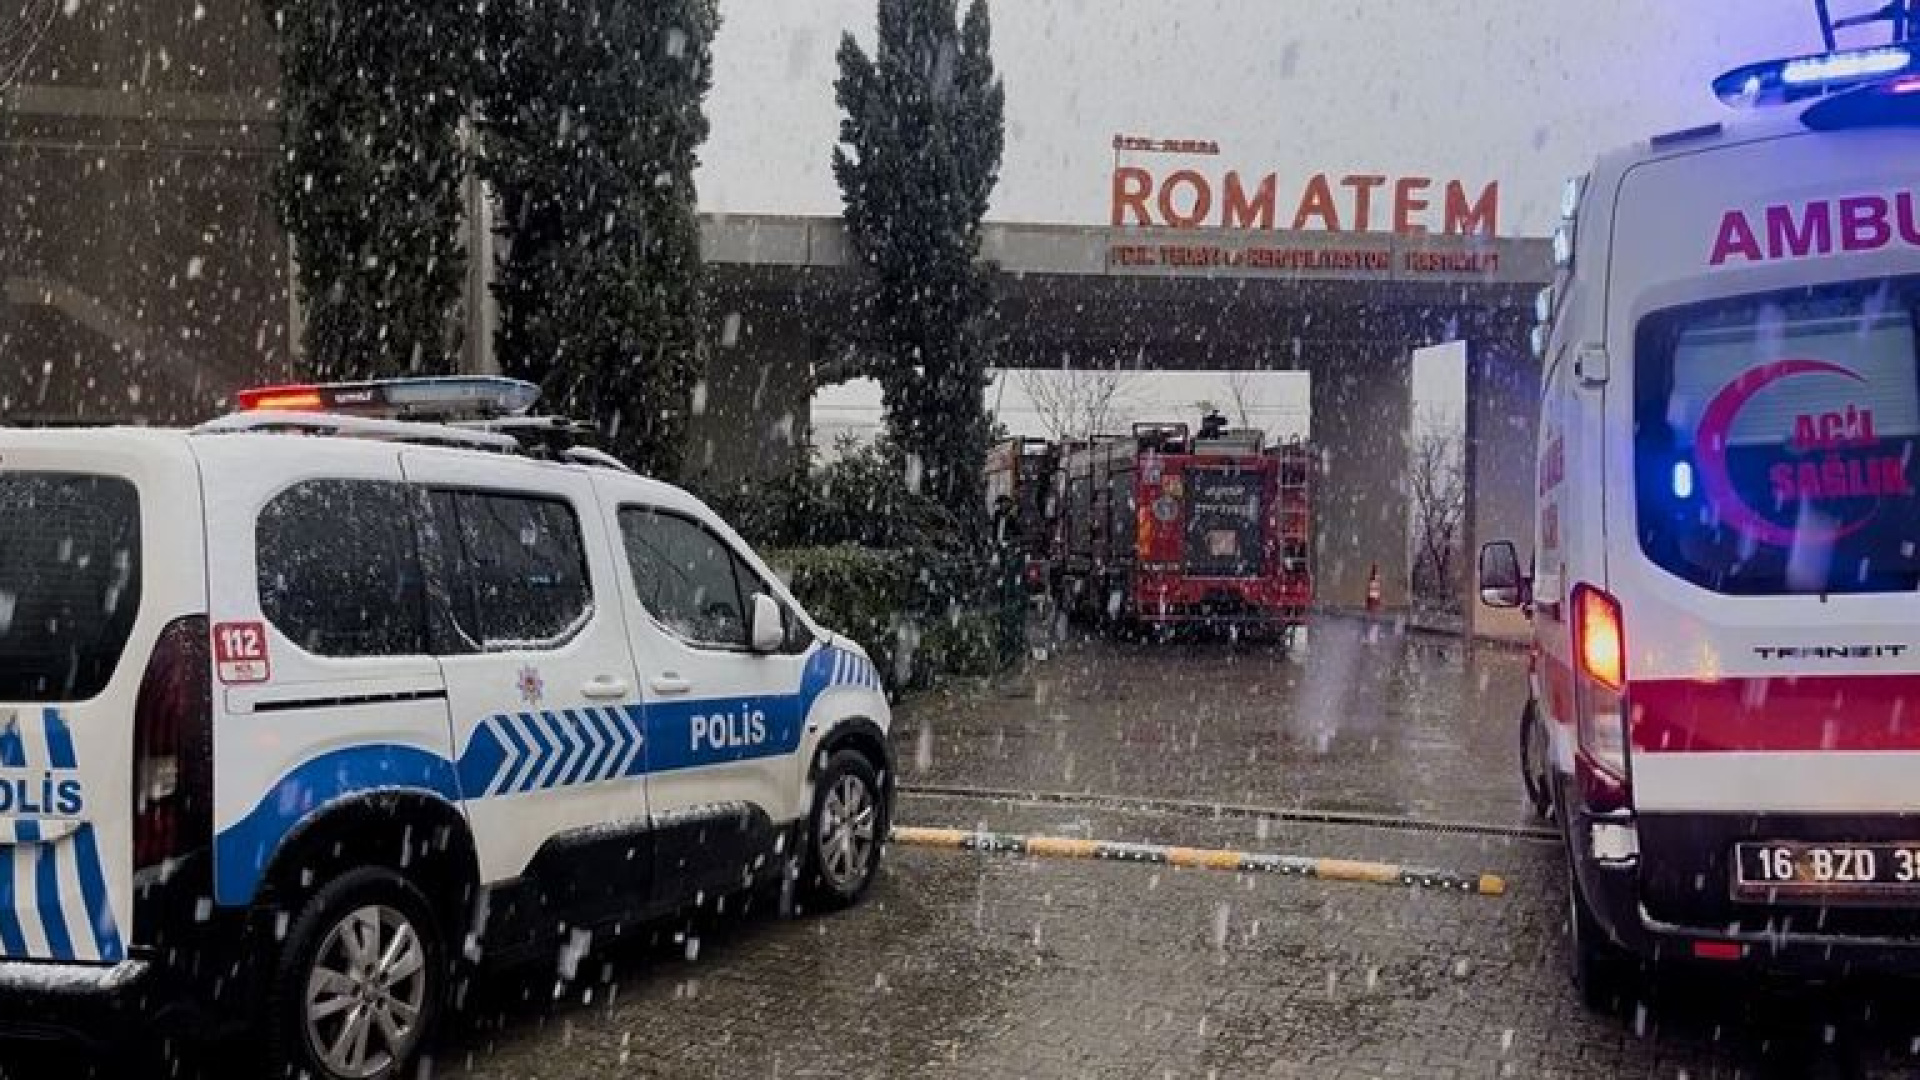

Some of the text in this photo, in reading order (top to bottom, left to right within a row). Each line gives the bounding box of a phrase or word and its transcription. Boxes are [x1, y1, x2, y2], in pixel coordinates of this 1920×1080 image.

[1111, 166, 1499, 239] ROMATEM
[221, 629, 261, 657] 112
[690, 702, 766, 751] POLİS
[1759, 848, 1793, 880] 16
[1812, 849, 1876, 881] BZD
